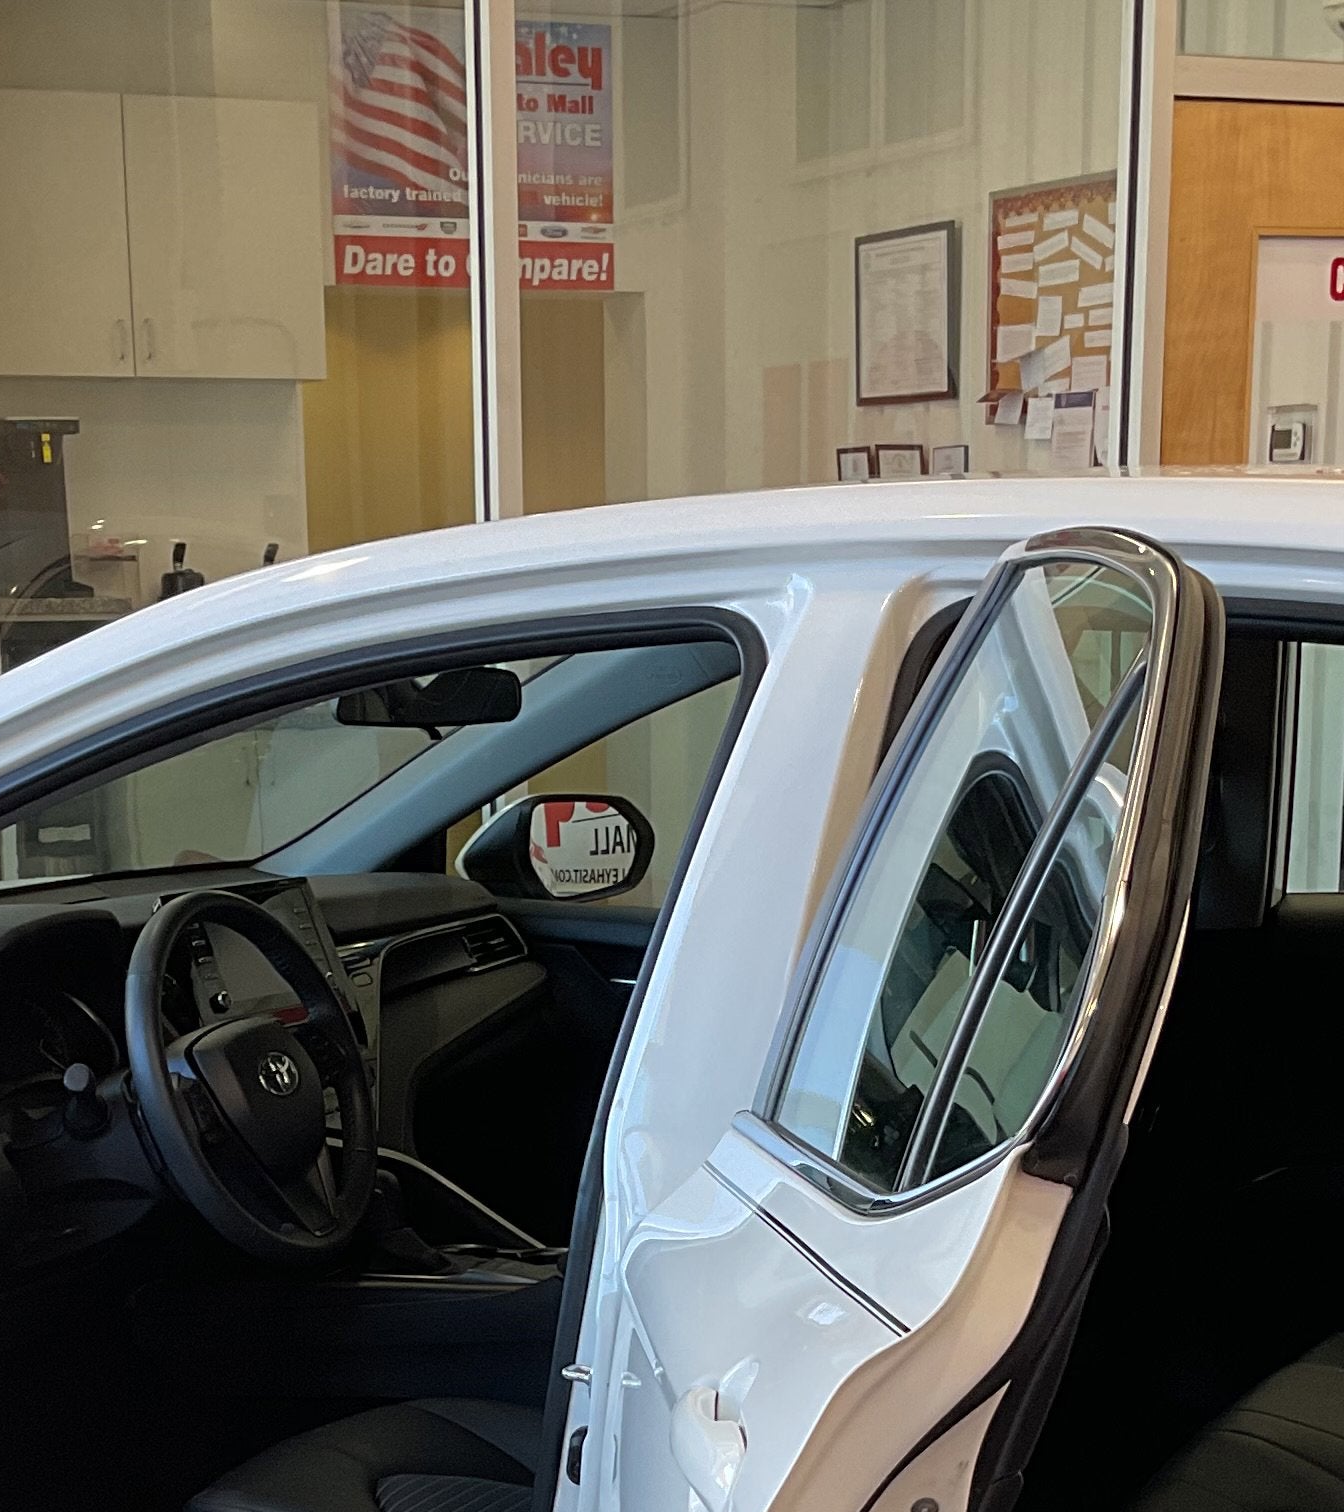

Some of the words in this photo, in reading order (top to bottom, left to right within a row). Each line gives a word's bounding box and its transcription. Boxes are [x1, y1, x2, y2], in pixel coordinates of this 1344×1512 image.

[547, 93, 594, 114] Mall
[579, 175, 603, 187] are
[343, 185, 401, 204] factory
[406, 187, 462, 203] trained
[544, 191, 604, 208] vehicle!
[343, 244, 417, 277] Dare
[425, 248, 457, 278] to
[465, 253, 610, 286] mpare!
